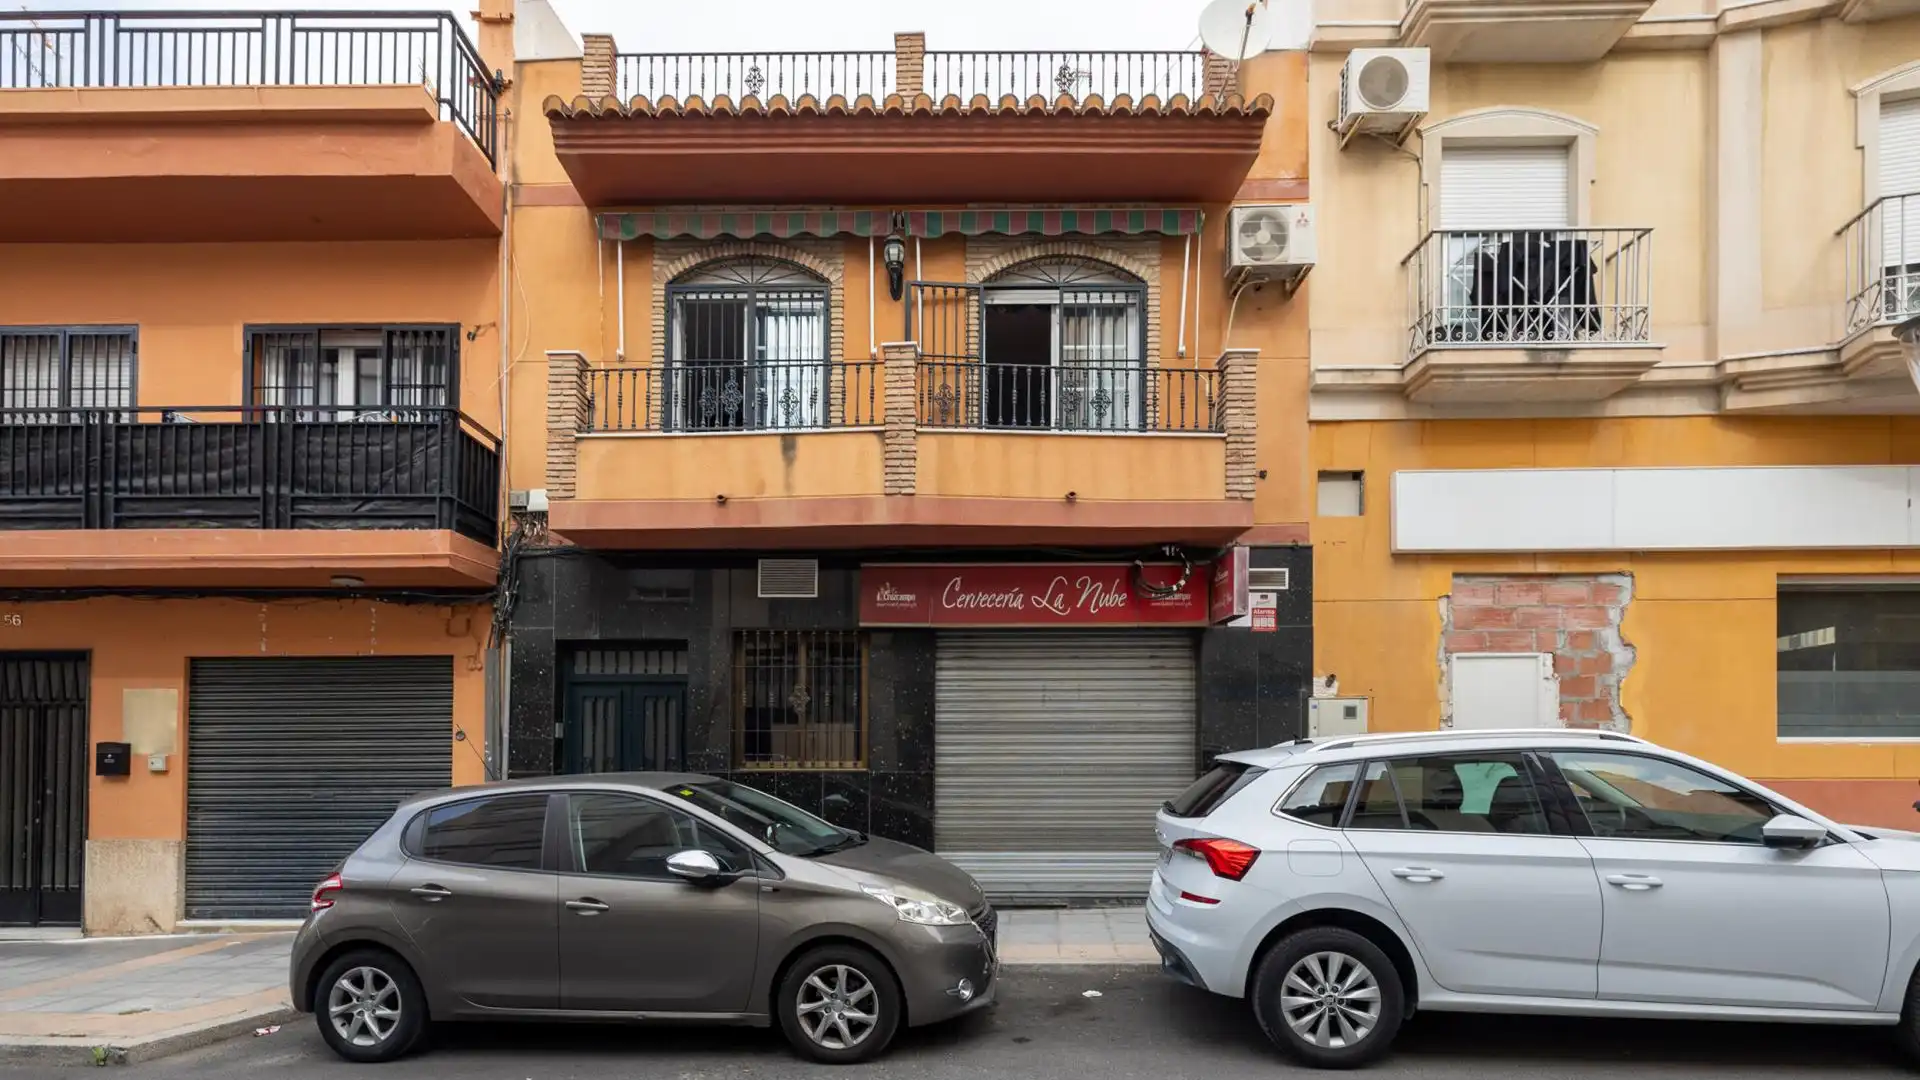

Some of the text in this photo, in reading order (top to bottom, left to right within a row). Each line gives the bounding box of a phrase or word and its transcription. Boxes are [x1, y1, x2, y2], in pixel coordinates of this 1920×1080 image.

[942, 575, 1128, 616] Cervecería La Nube
[4, 614, 22, 626] 56
